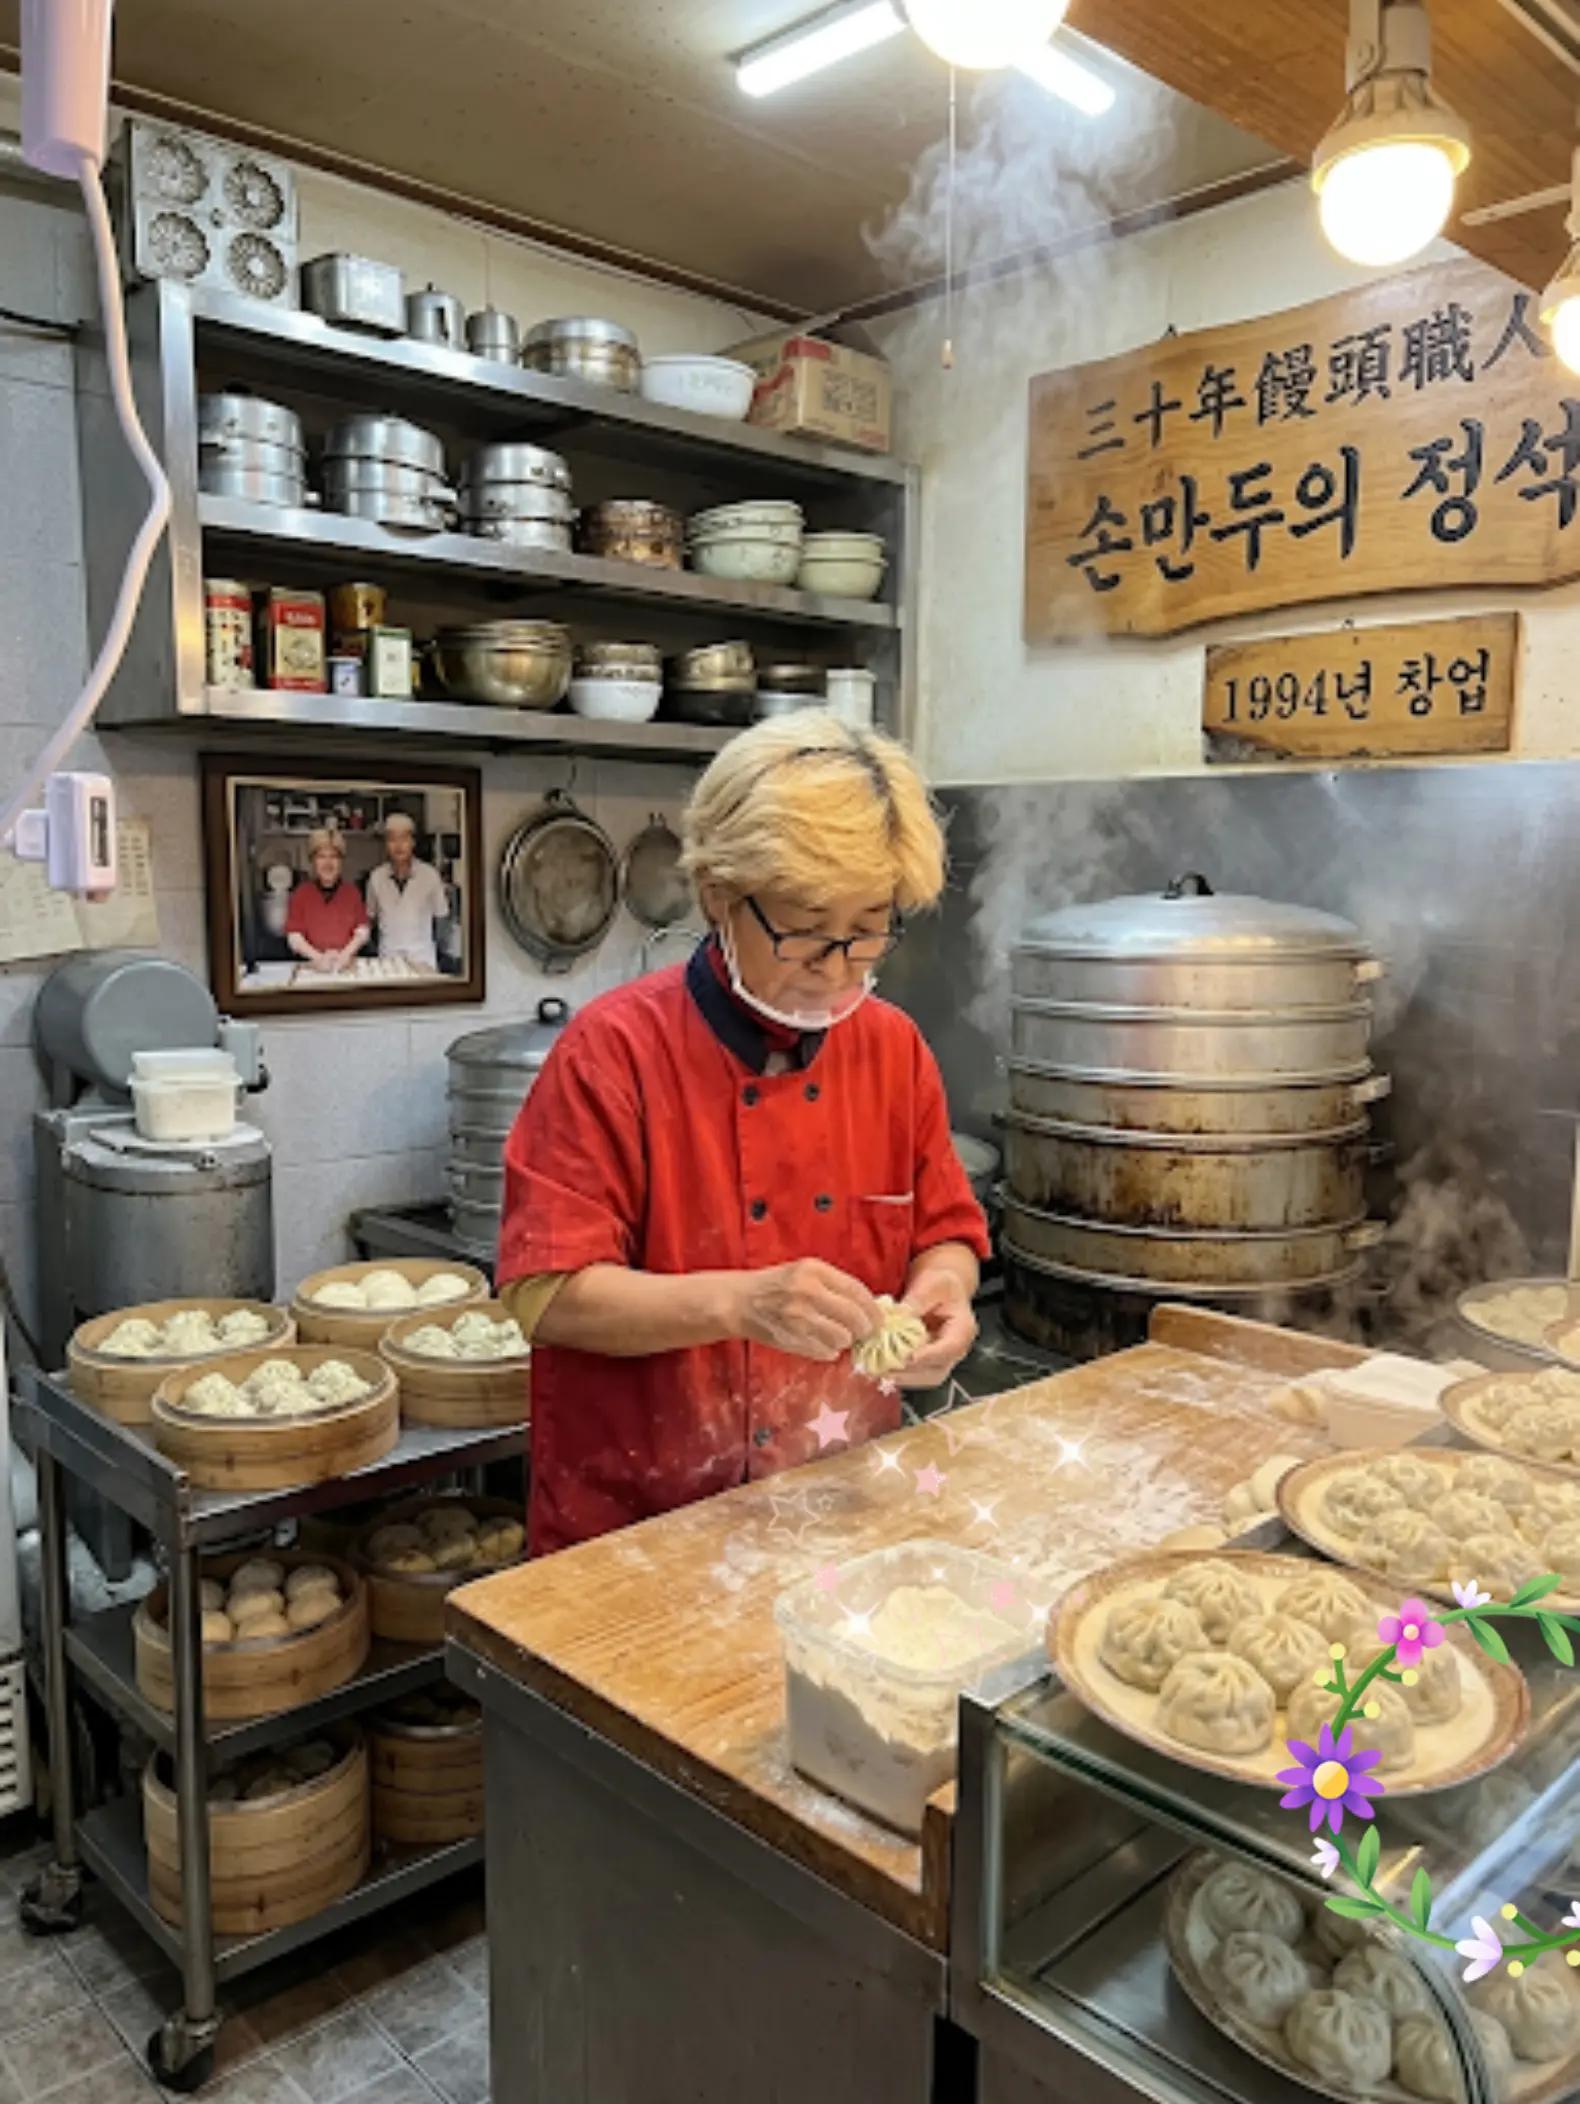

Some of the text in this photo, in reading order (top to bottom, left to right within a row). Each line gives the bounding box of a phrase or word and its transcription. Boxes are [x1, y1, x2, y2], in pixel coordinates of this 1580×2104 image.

[1077, 293, 1552, 460] 三十年饅頭職人
[1066, 445, 1361, 593] 손만두의
[1221, 648, 1491, 723] 1994년 창업
